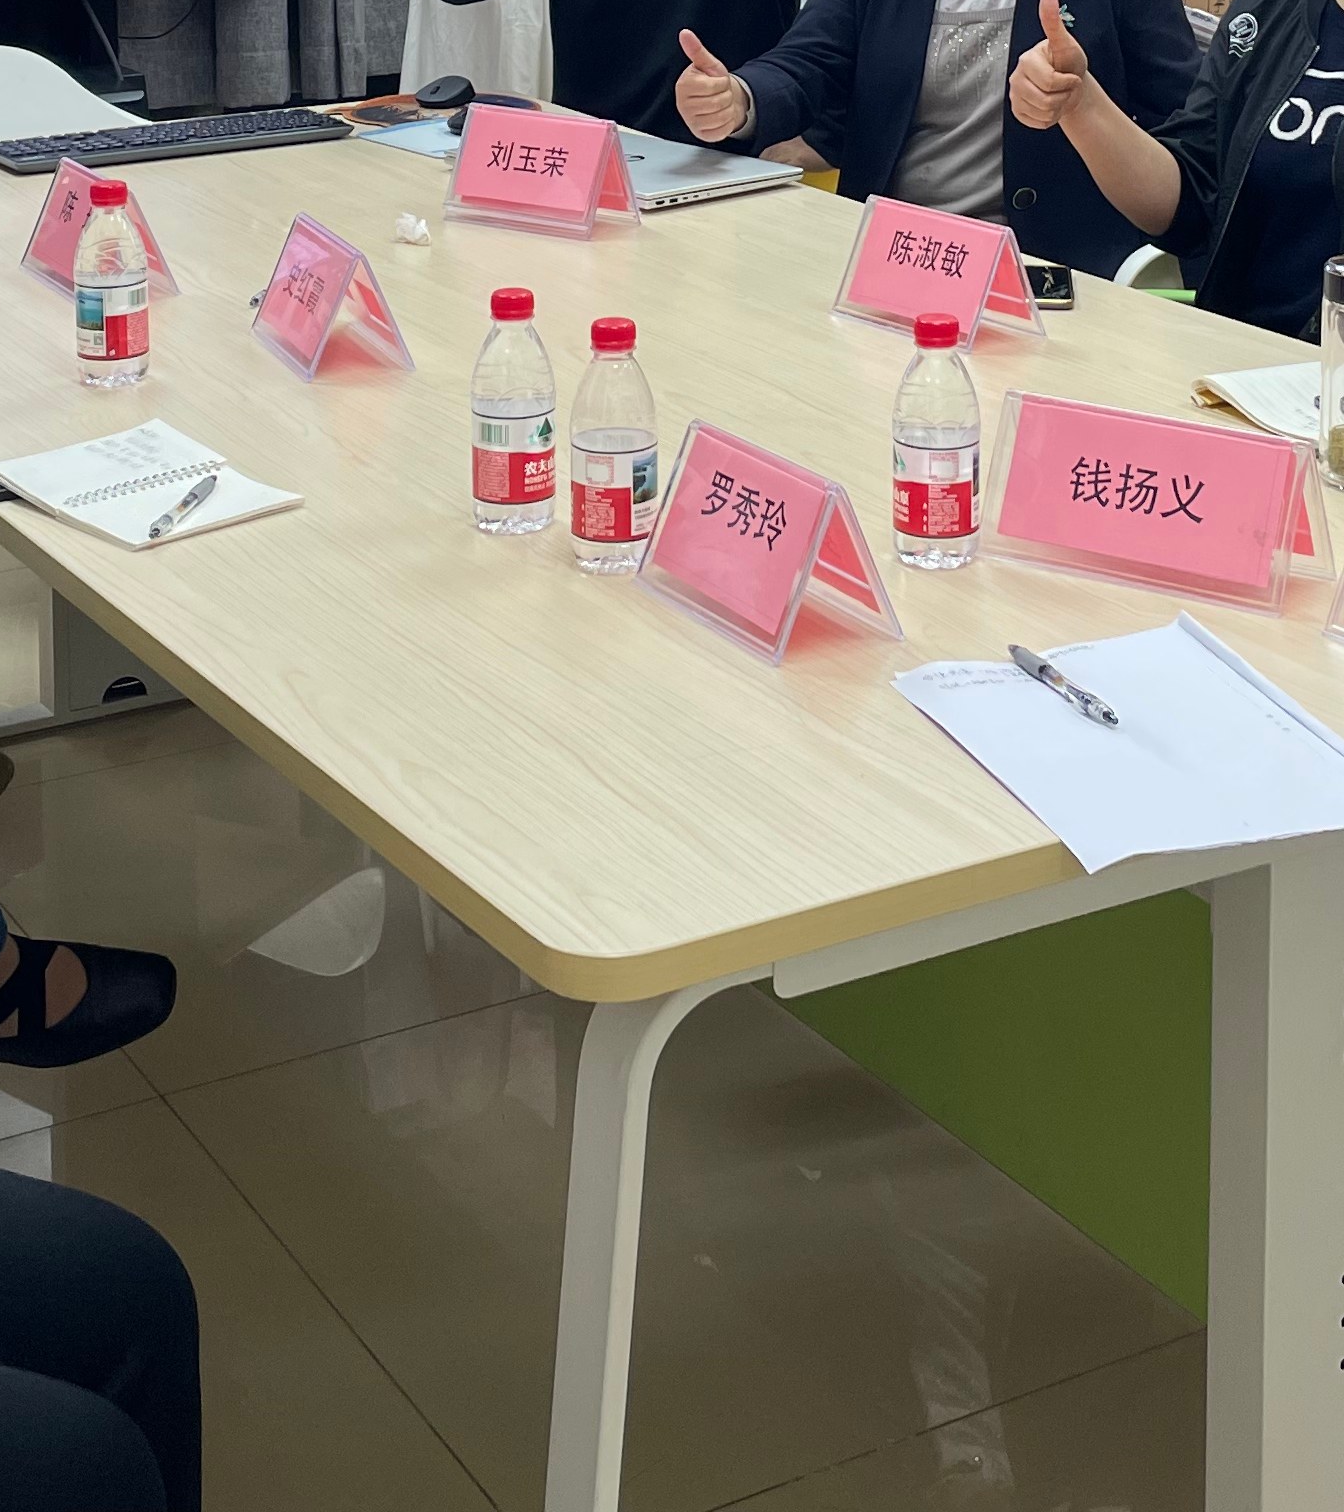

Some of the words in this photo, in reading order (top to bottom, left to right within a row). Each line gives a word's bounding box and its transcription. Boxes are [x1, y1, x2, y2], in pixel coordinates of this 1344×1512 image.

[488, 139, 569, 180] 刘玉荣
[886, 229, 971, 280] 陈淑敏
[700, 469, 789, 552] 罗秀玲
[1068, 455, 1207, 525] 钱扬义
